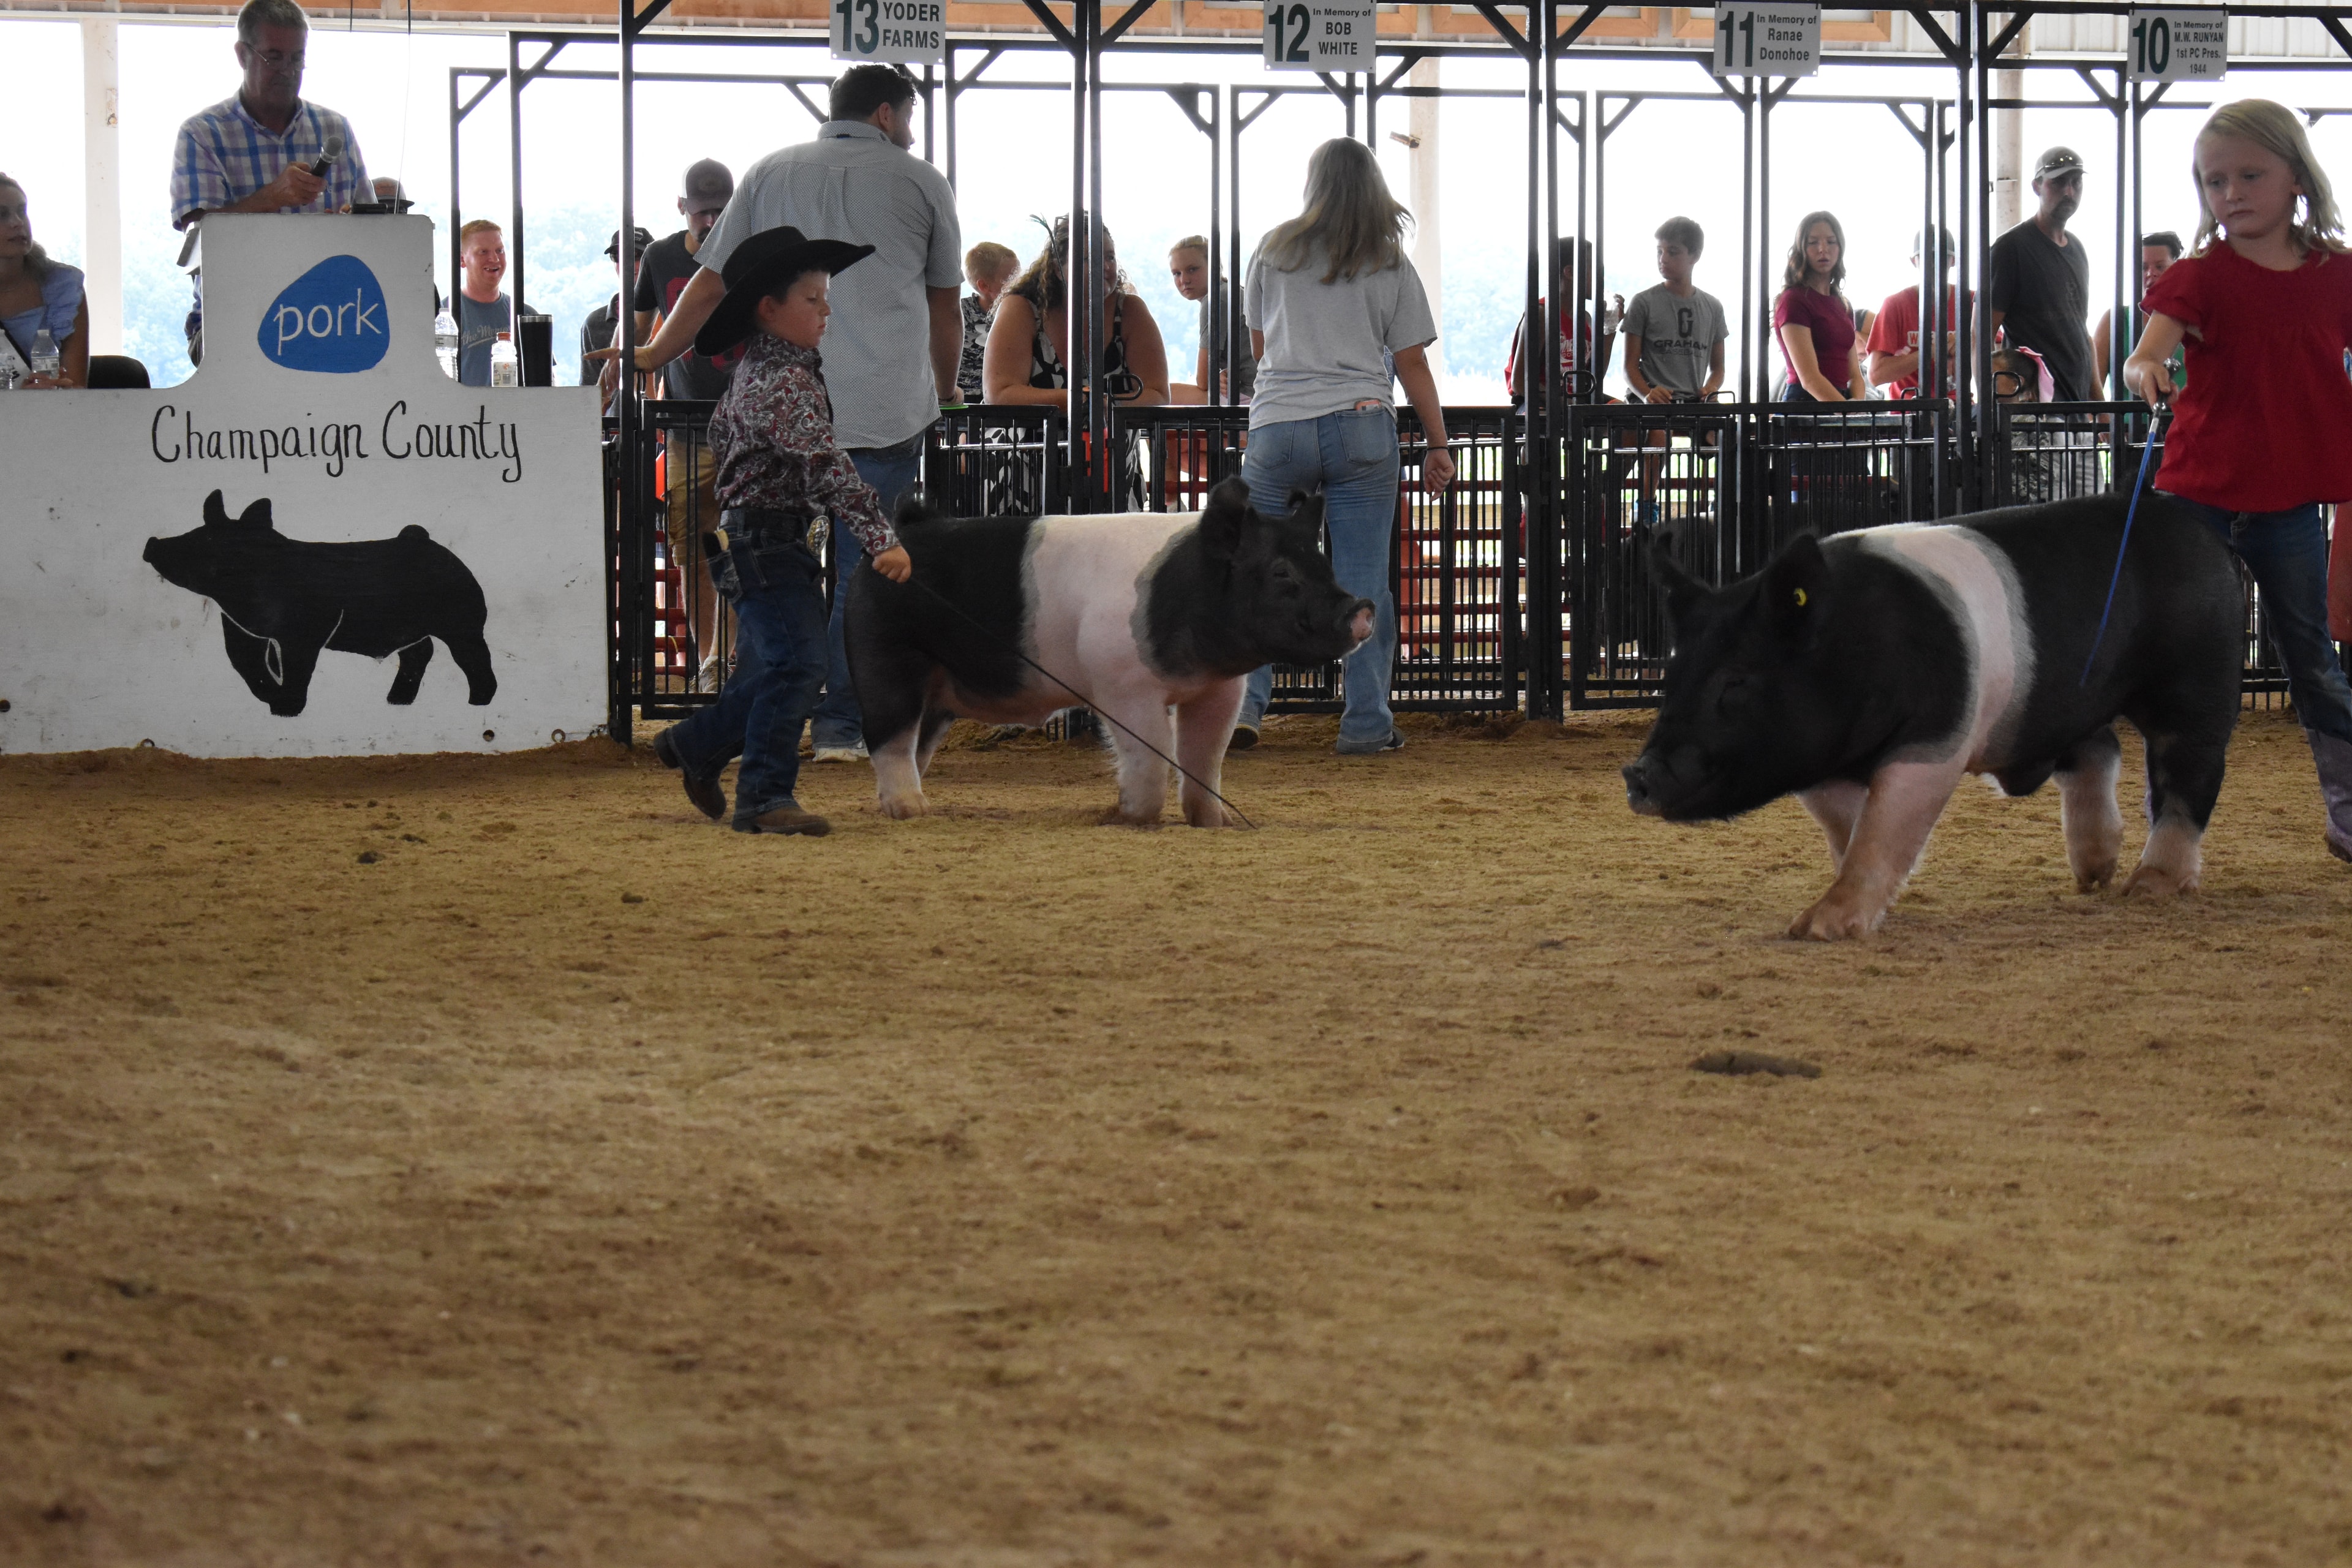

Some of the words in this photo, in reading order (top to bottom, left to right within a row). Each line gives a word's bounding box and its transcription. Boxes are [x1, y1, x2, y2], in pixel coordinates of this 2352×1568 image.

[883, 2, 940, 22] YODER
[1324, 9, 1359, 18] Memory
[836, 0, 879, 54] 13
[1768, 15, 1804, 26] Memory
[1807, 15, 1817, 24] of
[2184, 21, 2213, 30] Memory
[1268, 4, 1310, 62] 12
[1325, 21, 1351, 36] BOB
[1768, 28, 1803, 41] Ranae
[883, 29, 939, 49] FARMS
[1719, 11, 1754, 67] 11
[2174, 32, 2191, 42] M.W.
[2193, 32, 2223, 42] RUNYAN
[1318, 42, 1357, 55] WHITE
[2132, 17, 2169, 74] 10
[2176, 48, 2187, 58] 1st
[2189, 48, 2199, 58] PC
[2202, 48, 2220, 58] Pres.
[1760, 47, 1809, 61] Donohoe
[2190, 64, 2206, 74] 1944
[273, 288, 382, 356] pork
[1678, 307, 1694, 338] G
[152, 405, 369, 477] Champaign
[382, 400, 522, 483] County
